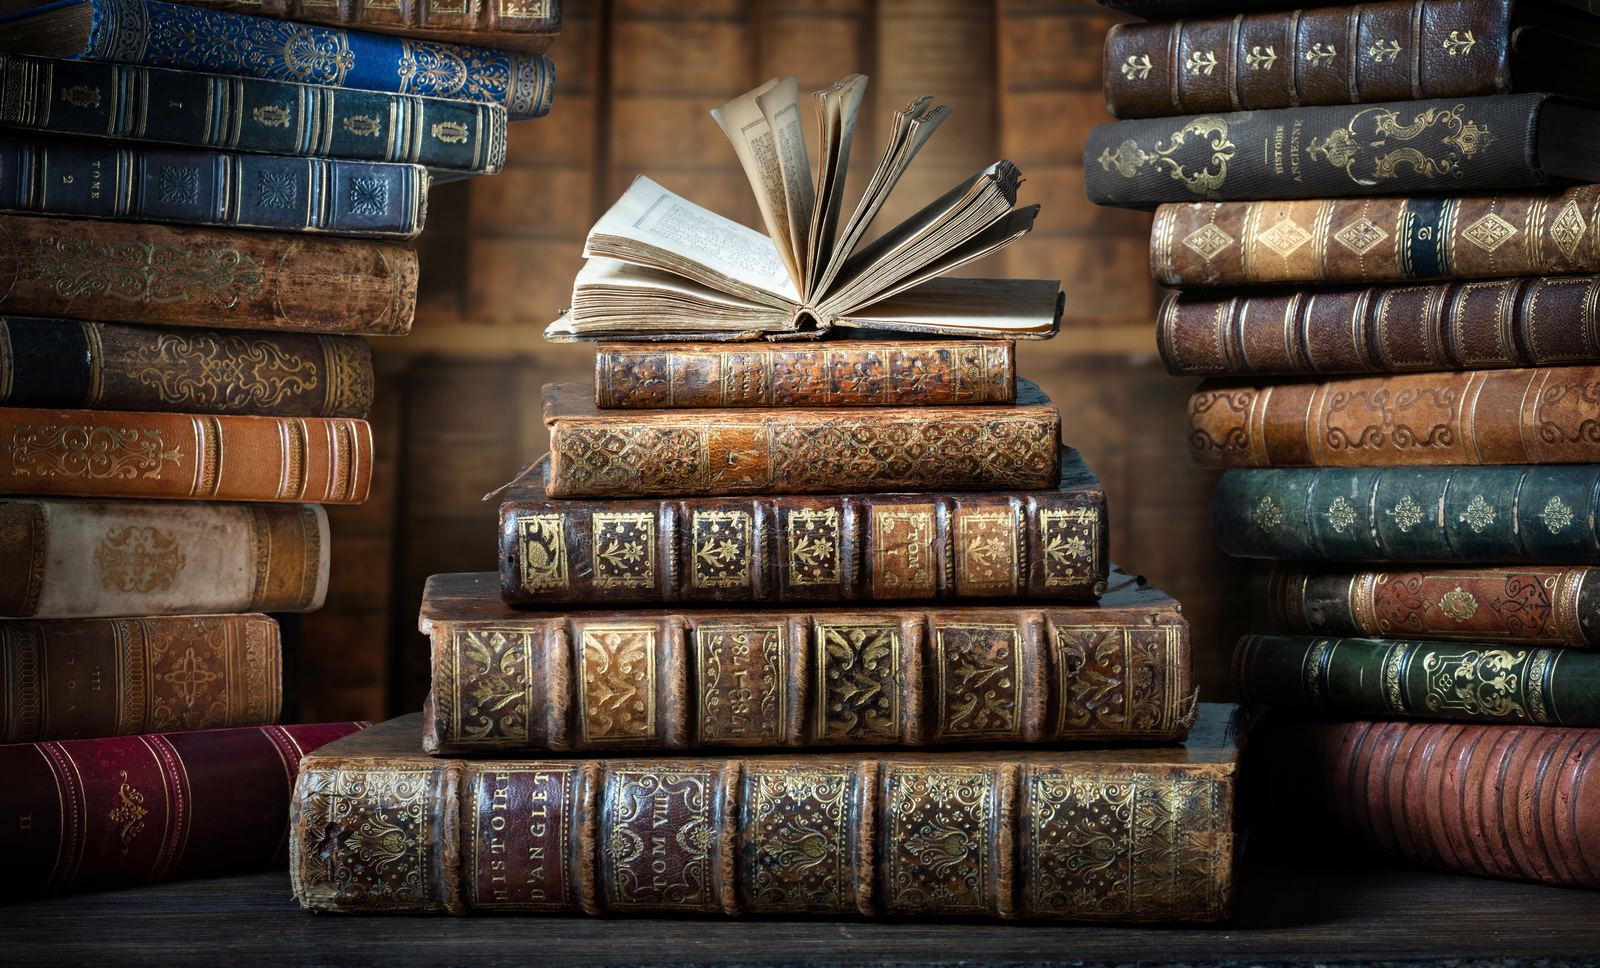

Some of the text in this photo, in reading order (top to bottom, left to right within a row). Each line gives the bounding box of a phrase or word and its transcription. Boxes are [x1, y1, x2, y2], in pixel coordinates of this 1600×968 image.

[1274, 125, 1284, 175] HISTOIRE
[1291, 119, 1304, 183] ANCIENNE
[62, 175, 74, 184] 2
[90, 160, 101, 199] TOME
[1418, 226, 1433, 241] 2
[906, 528, 919, 569] TOM
[490, 770, 509, 901] HISTOIRE
[527, 772, 549, 901] D'ANGLET
[652, 795, 669, 891] TOM VIII
